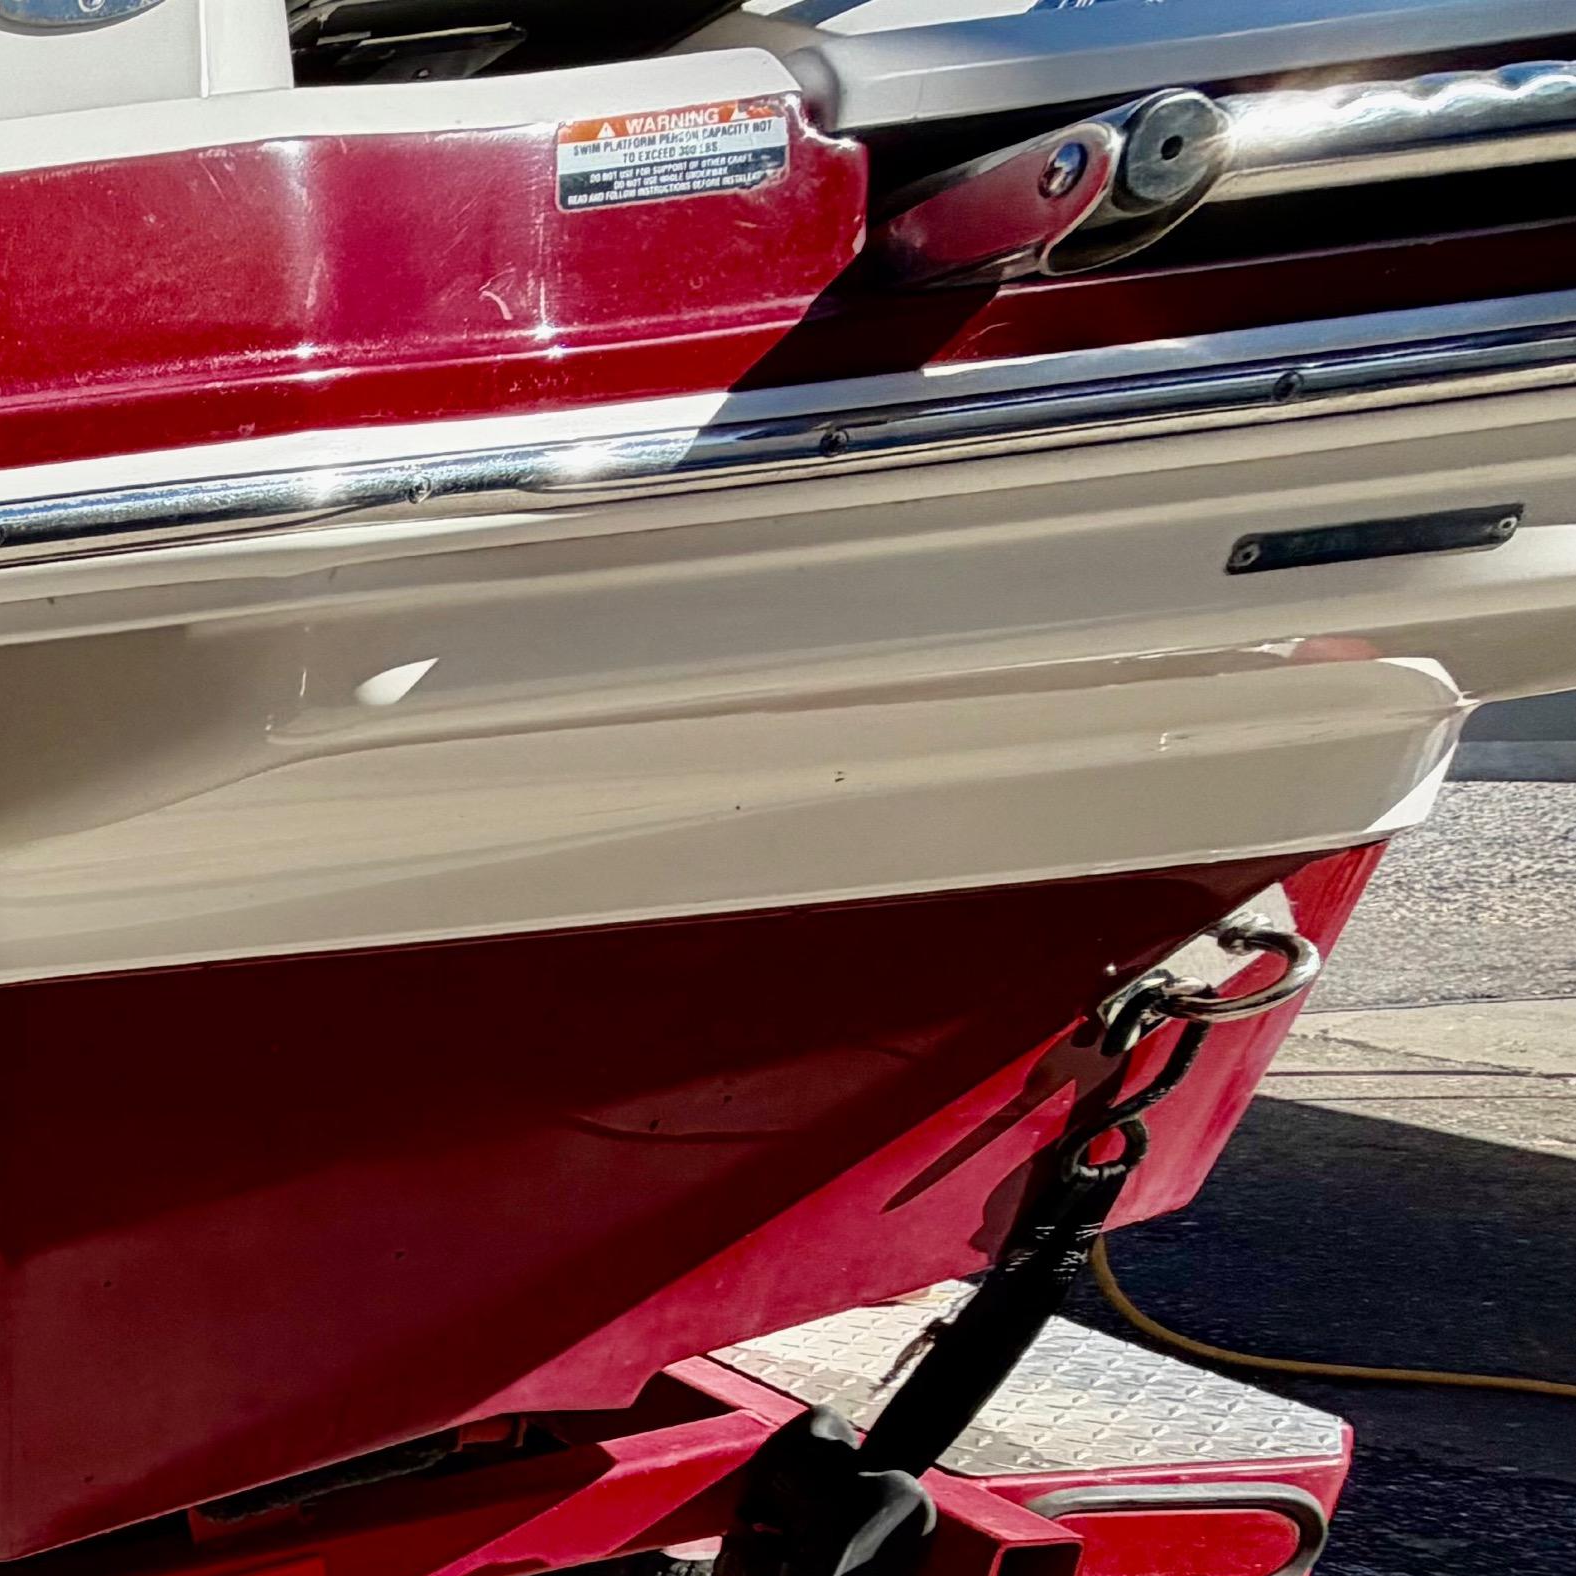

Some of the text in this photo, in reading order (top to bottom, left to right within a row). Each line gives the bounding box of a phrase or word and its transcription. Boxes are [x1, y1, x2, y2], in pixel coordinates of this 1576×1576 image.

[625, 107, 719, 136] WARNING
[573, 144, 601, 156] SWIM
[602, 136, 657, 153] PLATFORM
[702, 122, 750, 140] CAPACITY
[622, 153, 635, 164] TO
[637, 147, 676, 162] EXCEED
